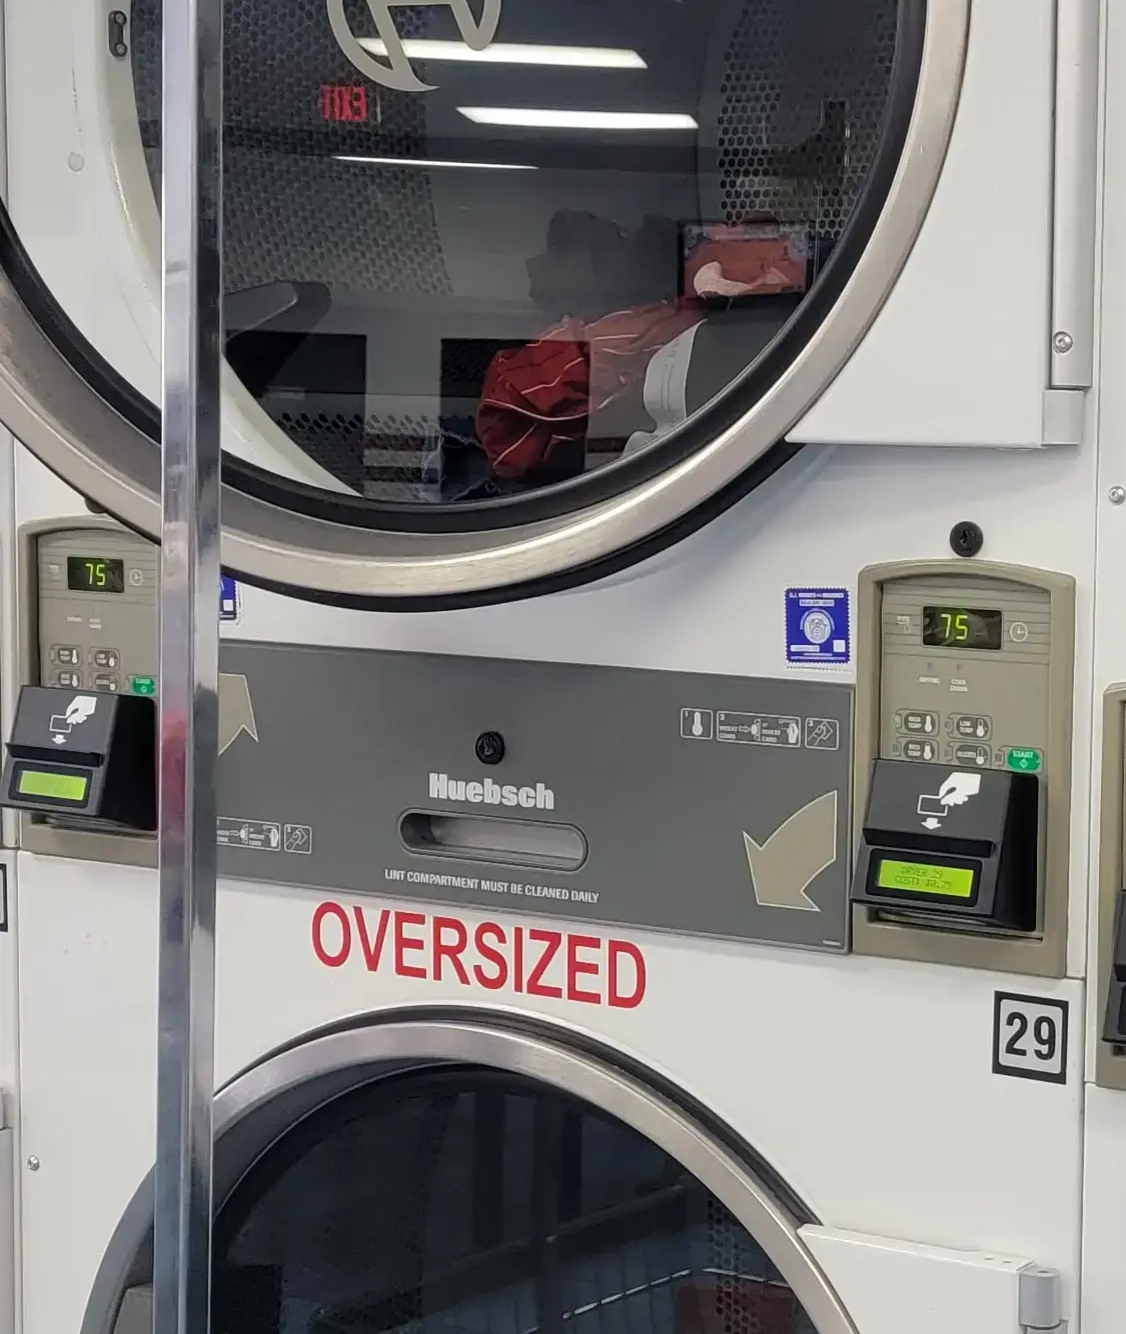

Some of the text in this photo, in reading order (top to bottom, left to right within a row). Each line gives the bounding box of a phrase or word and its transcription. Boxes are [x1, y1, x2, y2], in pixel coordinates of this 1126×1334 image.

[84, 562, 106, 586] 75
[940, 613, 968, 640] 75
[1012, 750, 1034, 758] START
[428, 772, 554, 810] Huebsch
[384, 868, 600, 903] LINT COMPARTMENT MUST BE CLEANED DAILY
[311, 900, 647, 1010] OVERSIZED
[1004, 1011, 1056, 1061] 29
